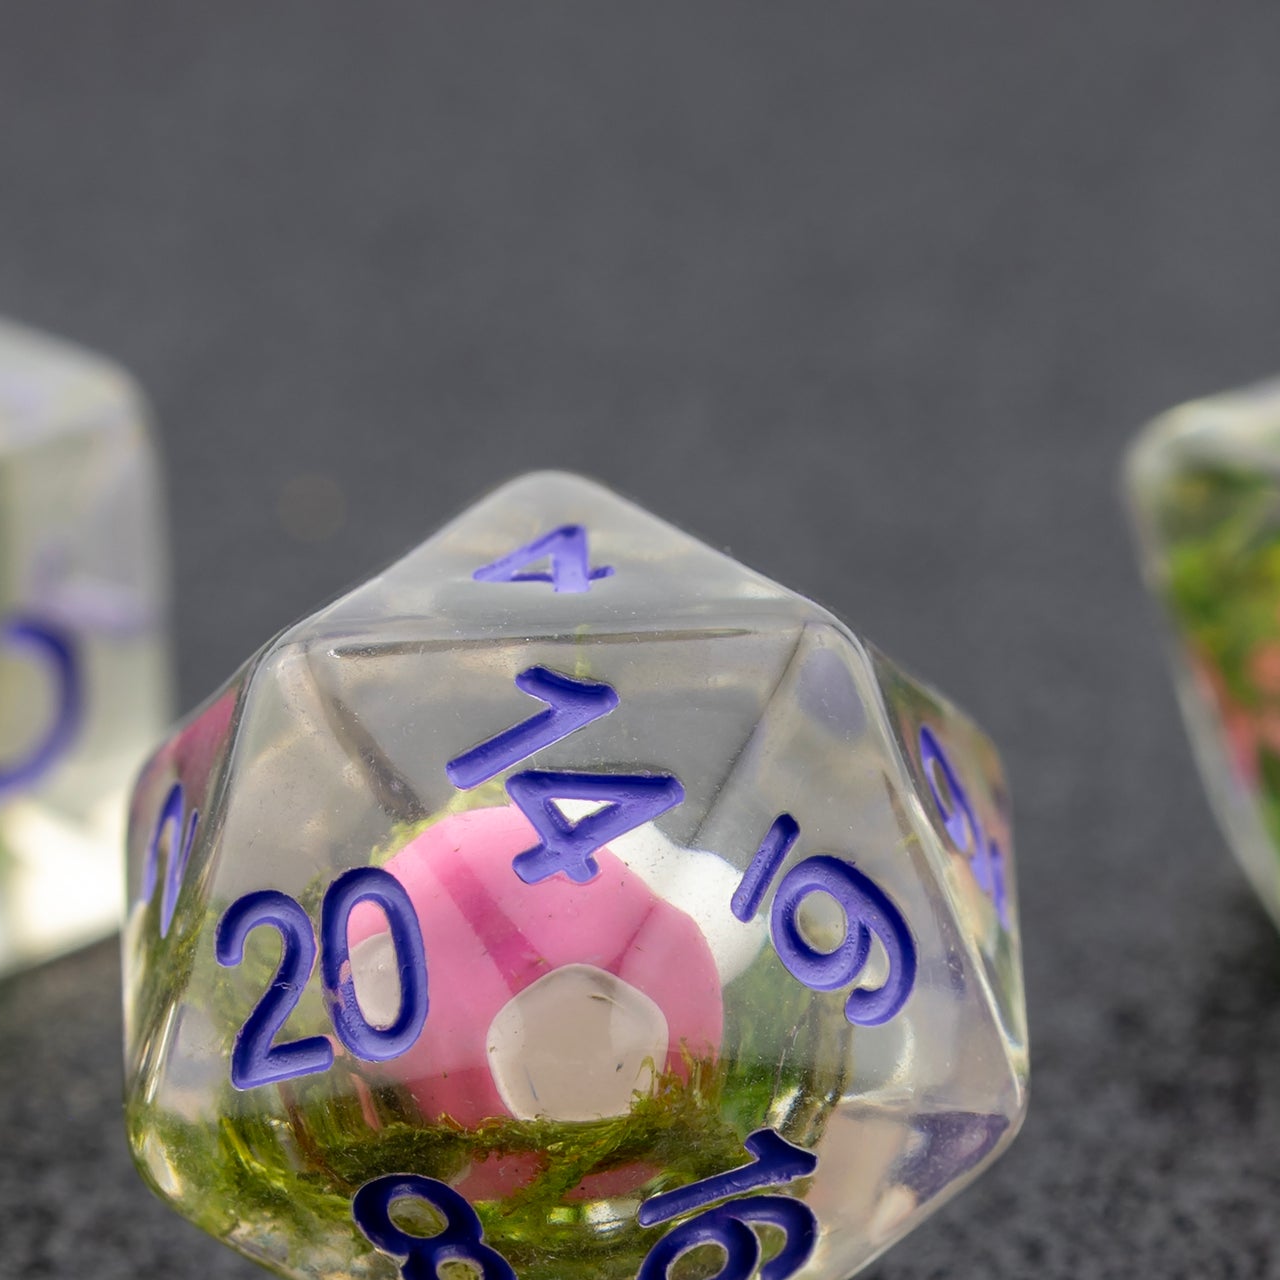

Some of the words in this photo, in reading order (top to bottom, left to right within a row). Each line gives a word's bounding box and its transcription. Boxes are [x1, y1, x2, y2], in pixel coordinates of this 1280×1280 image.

[473, 524, 616, 594] 4
[445, 665, 685, 884] 14
[215, 866, 429, 1091] 20
